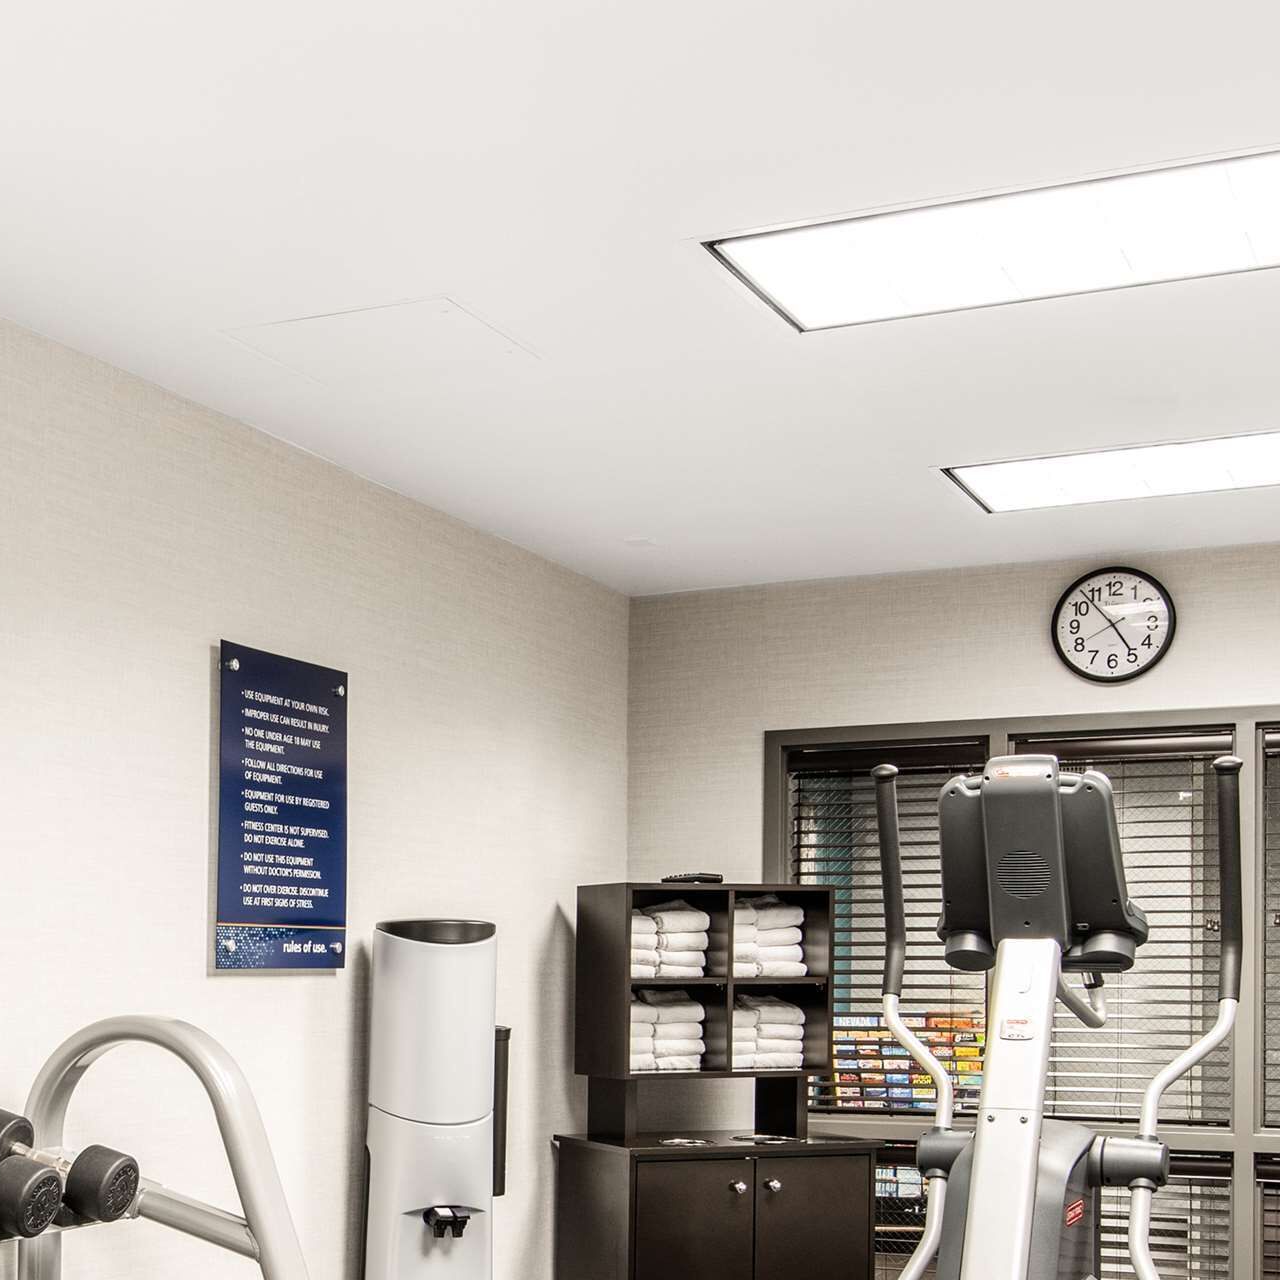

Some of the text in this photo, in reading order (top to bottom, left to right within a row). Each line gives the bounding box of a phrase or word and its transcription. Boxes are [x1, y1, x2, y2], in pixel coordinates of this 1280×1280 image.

[1088, 587, 1102, 602] 11
[1106, 581, 1123, 596] 12
[1131, 585, 1137, 600] 1
[1072, 601, 1089, 616] 10
[1070, 620, 1080, 635] 9
[1147, 615, 1159, 631] 3
[1074, 637, 1085, 652] 8
[1141, 634, 1153, 649] 4
[1088, 650, 1099, 665] 7
[1107, 654, 1118, 669] 6
[1127, 648, 1138, 663] 5
[244, 690, 254, 700] USE
[255, 692, 284, 705] EQUIPMENT
[284, 698, 291, 707] AT
[291, 700, 305, 711] YOUR
[306, 703, 317, 713] OWN
[245, 708, 269, 721] IMPROPER
[270, 714, 279, 723] USE
[280, 716, 290, 725] CAN
[291, 718, 307, 729] RESULT
[245, 727, 253, 736] NO
[254, 729, 265, 739] ONE
[265, 731, 283, 742] UNDER
[283, 735, 294, 744] AGE
[301, 738, 311, 747] MAY
[312, 740, 321, 750] USE
[245, 739, 255, 749] THE
[245, 758, 323, 779] FOLLOW ALL DIRECTIONS FOR USE
[245, 771, 252, 780] OF
[245, 790, 274, 801] EQUIPMENT
[275, 794, 285, 804] FOR
[285, 796, 295, 805] USE
[295, 797, 302, 805] BY
[245, 802, 263, 813] GUESTS
[245, 821, 264, 831] FITNESS
[265, 823, 284, 833] CENTER
[290, 826, 300, 836] NOT
[244, 834, 253, 843] DO
[254, 835, 264, 844] NOT
[244, 852, 314, 866] DO NOT USE THIS EQUIPMENT
[244, 865, 268, 875] WITHOUT
[243, 884, 251, 893] DO
[252, 885, 263, 894] NOT
[263, 885, 276, 894] OVER
[243, 897, 253, 906] USE
[254, 897, 261, 906] AT
[274, 898, 289, 908] SIGNS
[290, 899, 296, 908] OF
[283, 941, 328, 953] rules of use.
